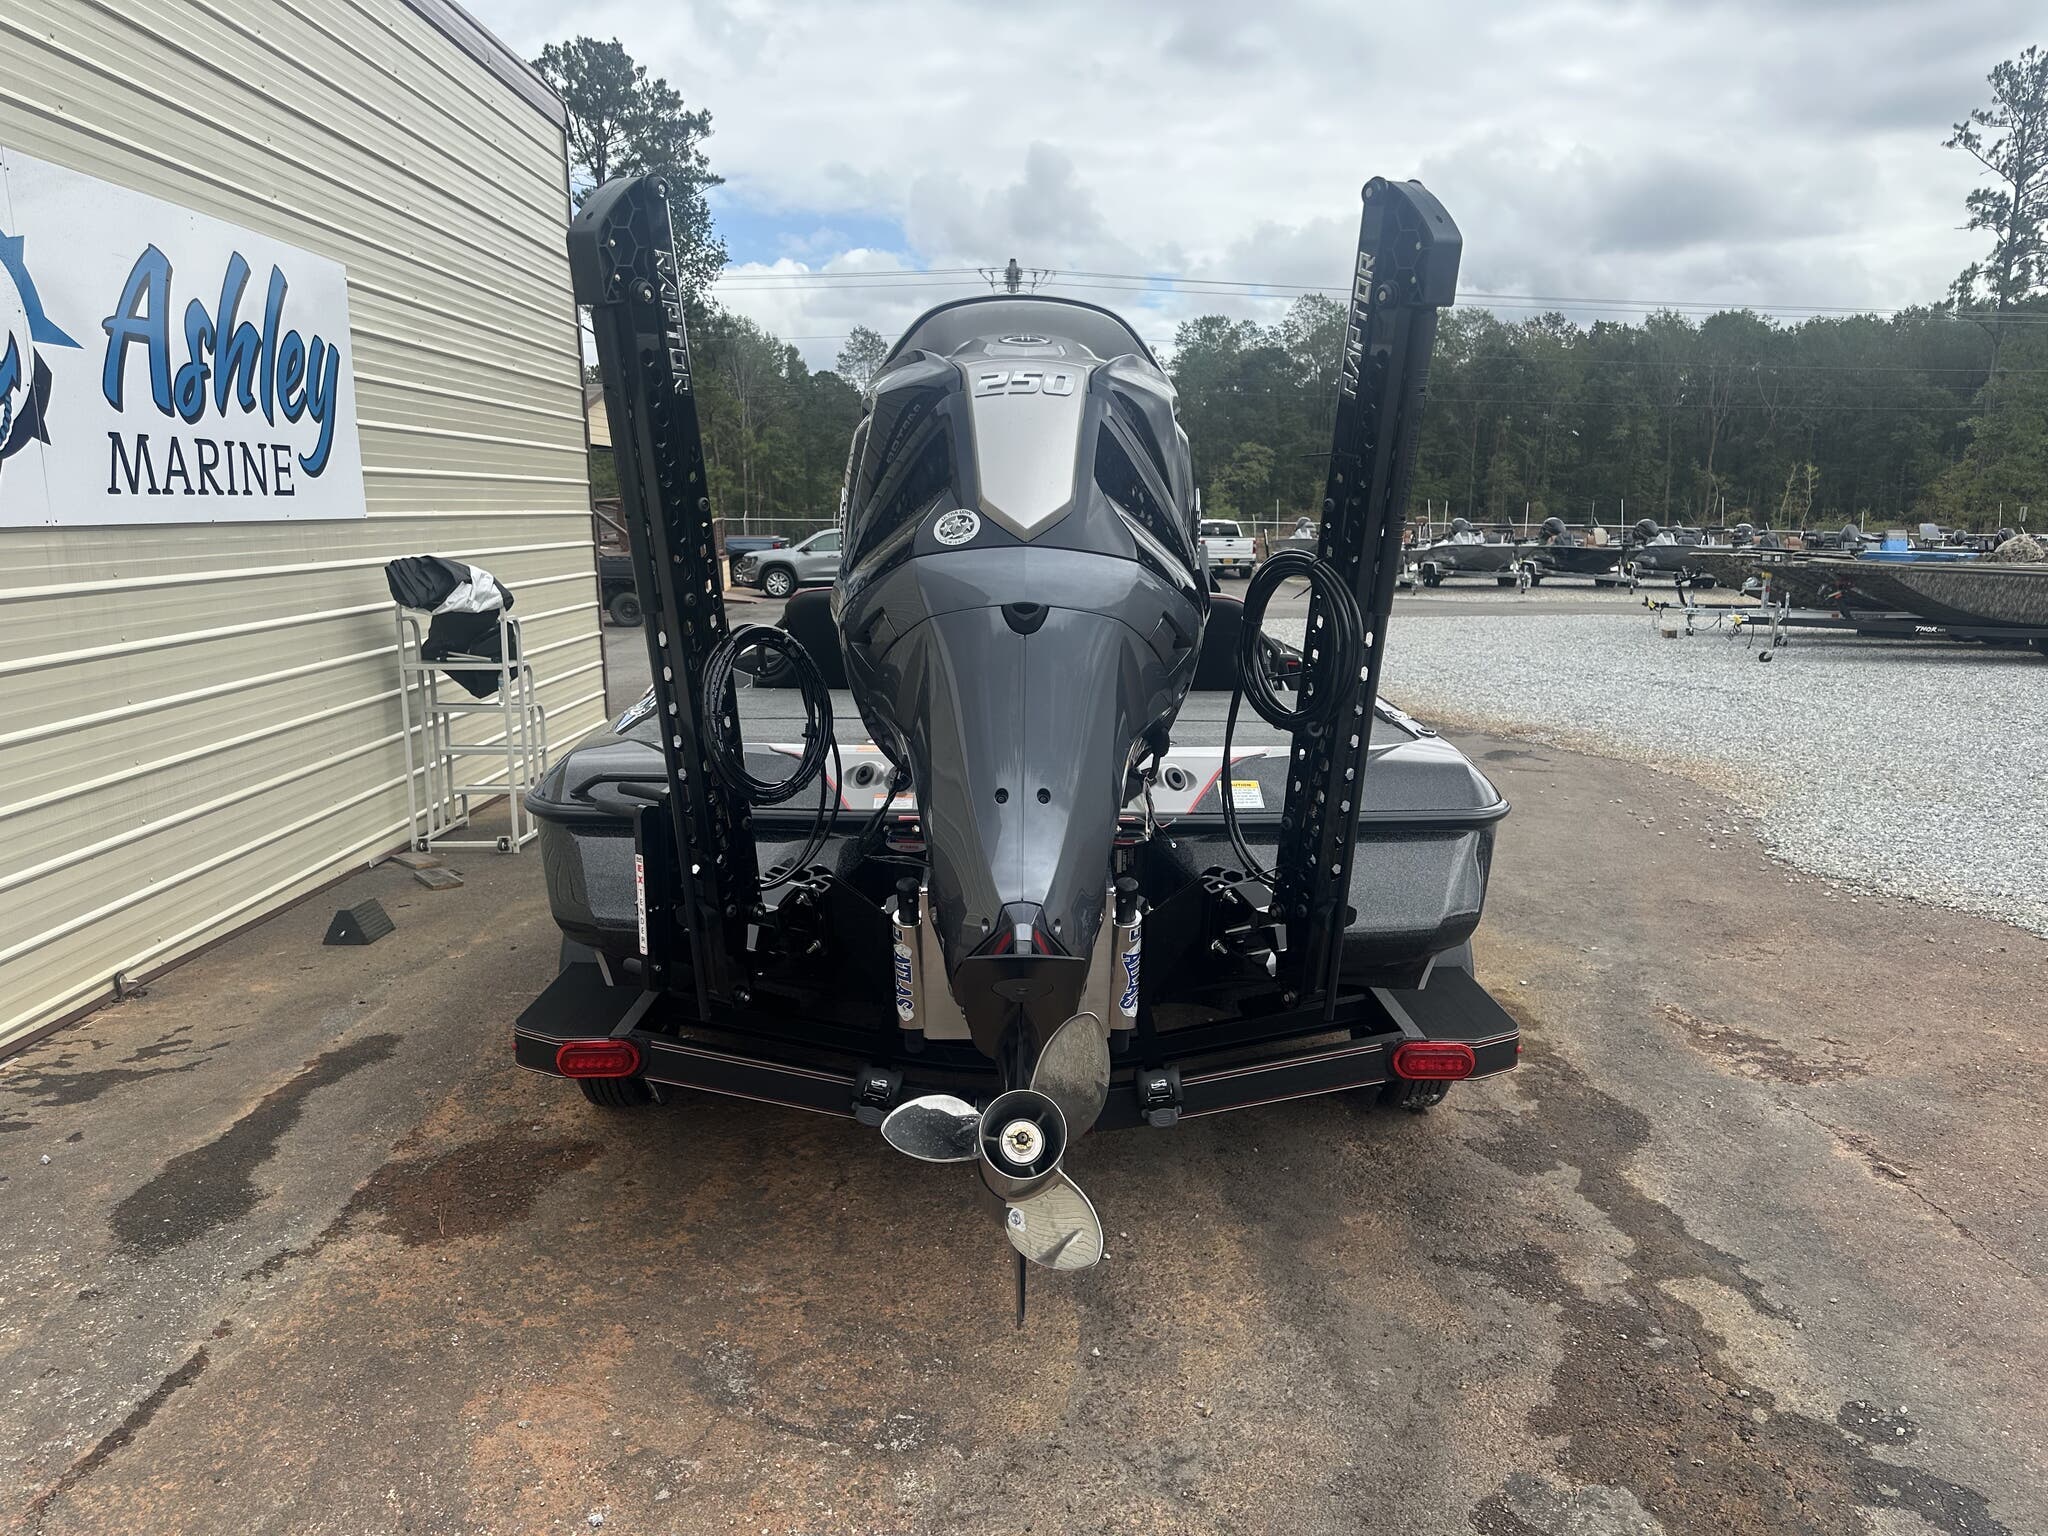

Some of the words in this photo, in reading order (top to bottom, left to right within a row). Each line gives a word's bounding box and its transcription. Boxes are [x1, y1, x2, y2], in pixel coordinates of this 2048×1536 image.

[102, 243, 340, 477] Ashley
[654, 249, 691, 394] RAPTOR
[1342, 251, 1375, 400] RAPTOR
[975, 371, 1076, 397] 250
[107, 432, 295, 497] MARINE
[895, 951, 914, 1011] ATLAS
